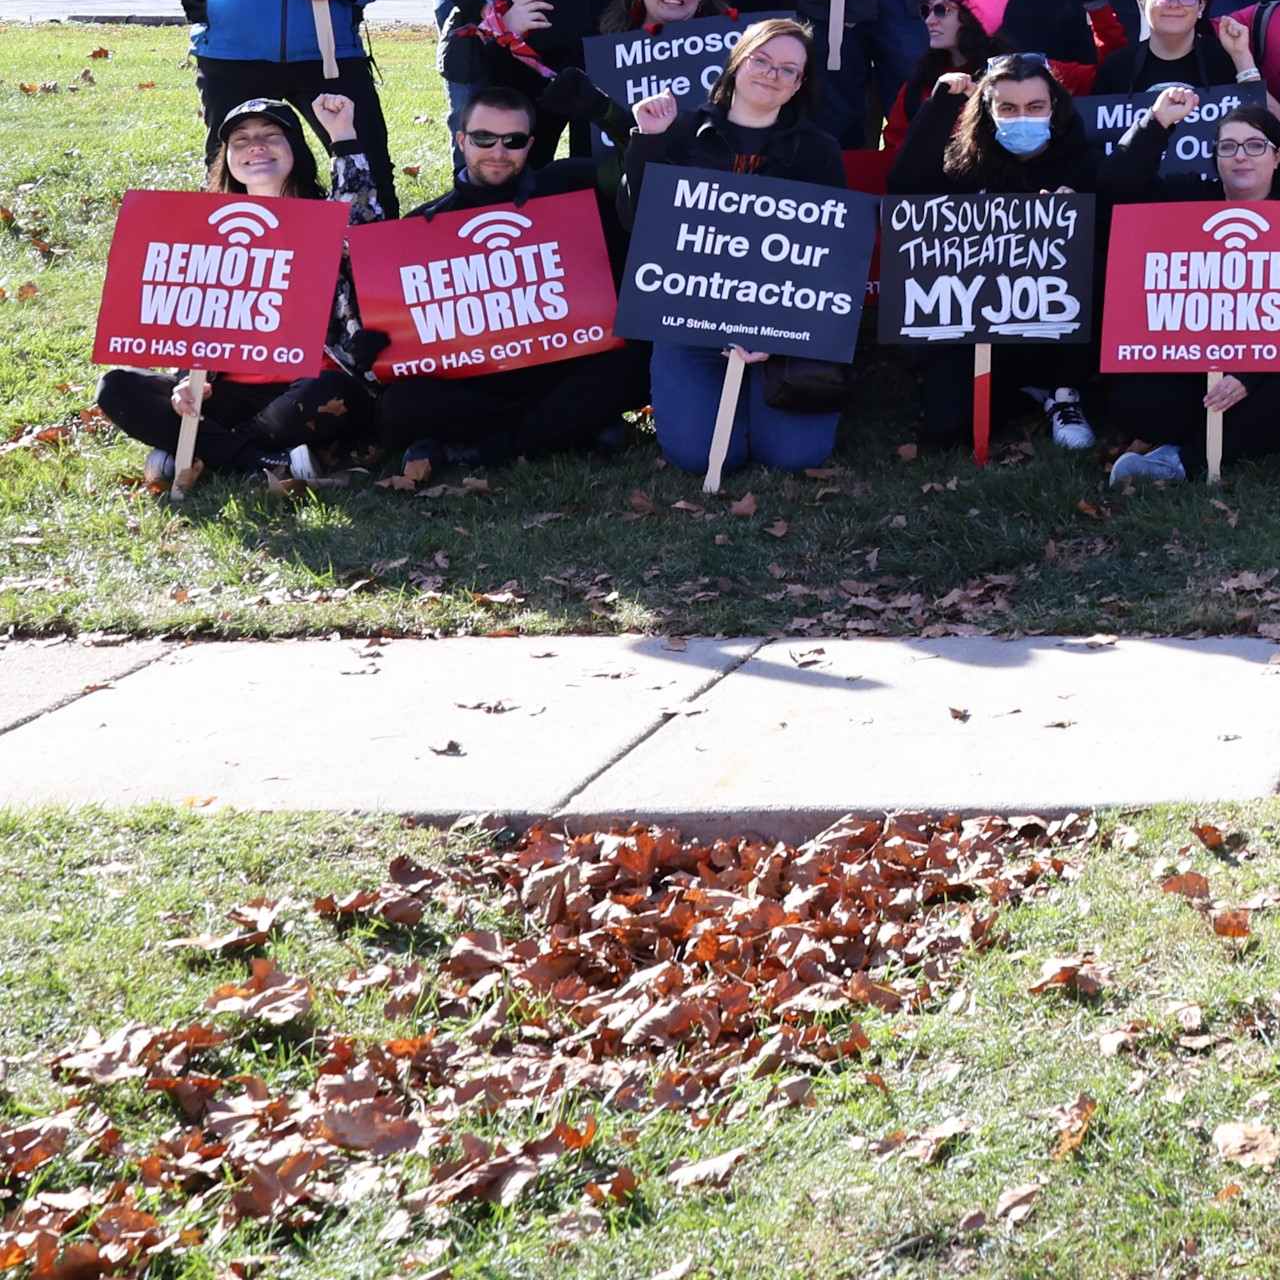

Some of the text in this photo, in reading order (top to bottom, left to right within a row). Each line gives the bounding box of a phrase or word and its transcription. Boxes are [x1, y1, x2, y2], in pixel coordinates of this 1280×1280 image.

[674, 179, 847, 231] Microsoft
[891, 195, 1077, 241] OUTSOURCING
[142, 242, 294, 290] REMOTE
[676, 223, 829, 267] Hire Our
[899, 233, 1066, 273] THREATENS
[141, 284, 283, 332] WORKS
[635, 263, 852, 314] Contractors
[903, 273, 1080, 326] MY JOB
[109, 337, 304, 364] RTO HAS GOT TO GO
[1118, 345, 1157, 360] RTO
[1162, 345, 1201, 360] HAS
[1206, 345, 1247, 360] GOT
[1251, 344, 1277, 360] TO
